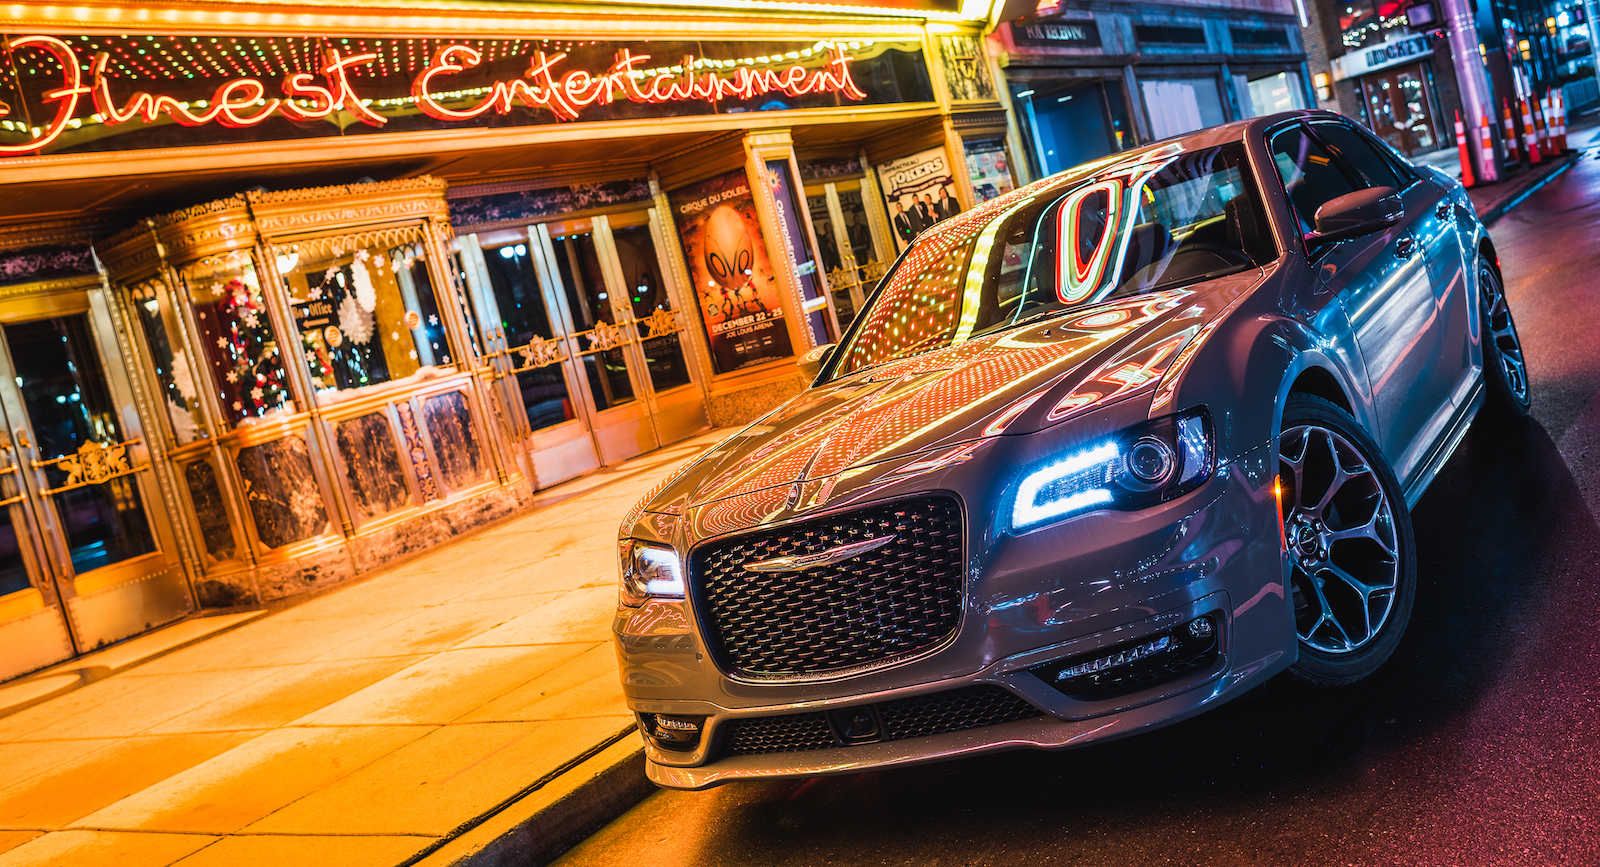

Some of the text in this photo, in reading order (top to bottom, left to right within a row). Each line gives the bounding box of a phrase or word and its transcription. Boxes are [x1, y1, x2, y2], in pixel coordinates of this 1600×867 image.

[0, 35, 868, 154] Finest Entertainment
[889, 157, 945, 190] JOKERS
[680, 185, 750, 214] CIRQUE DU SOLEIL
[709, 249, 749, 278] OVO
[712, 315, 755, 332] DECEMBER
[755, 311, 765, 322] 22
[771, 306, 783, 317] 25
[737, 325, 753, 336] LOUIS
[753, 321, 774, 332] ARENA
